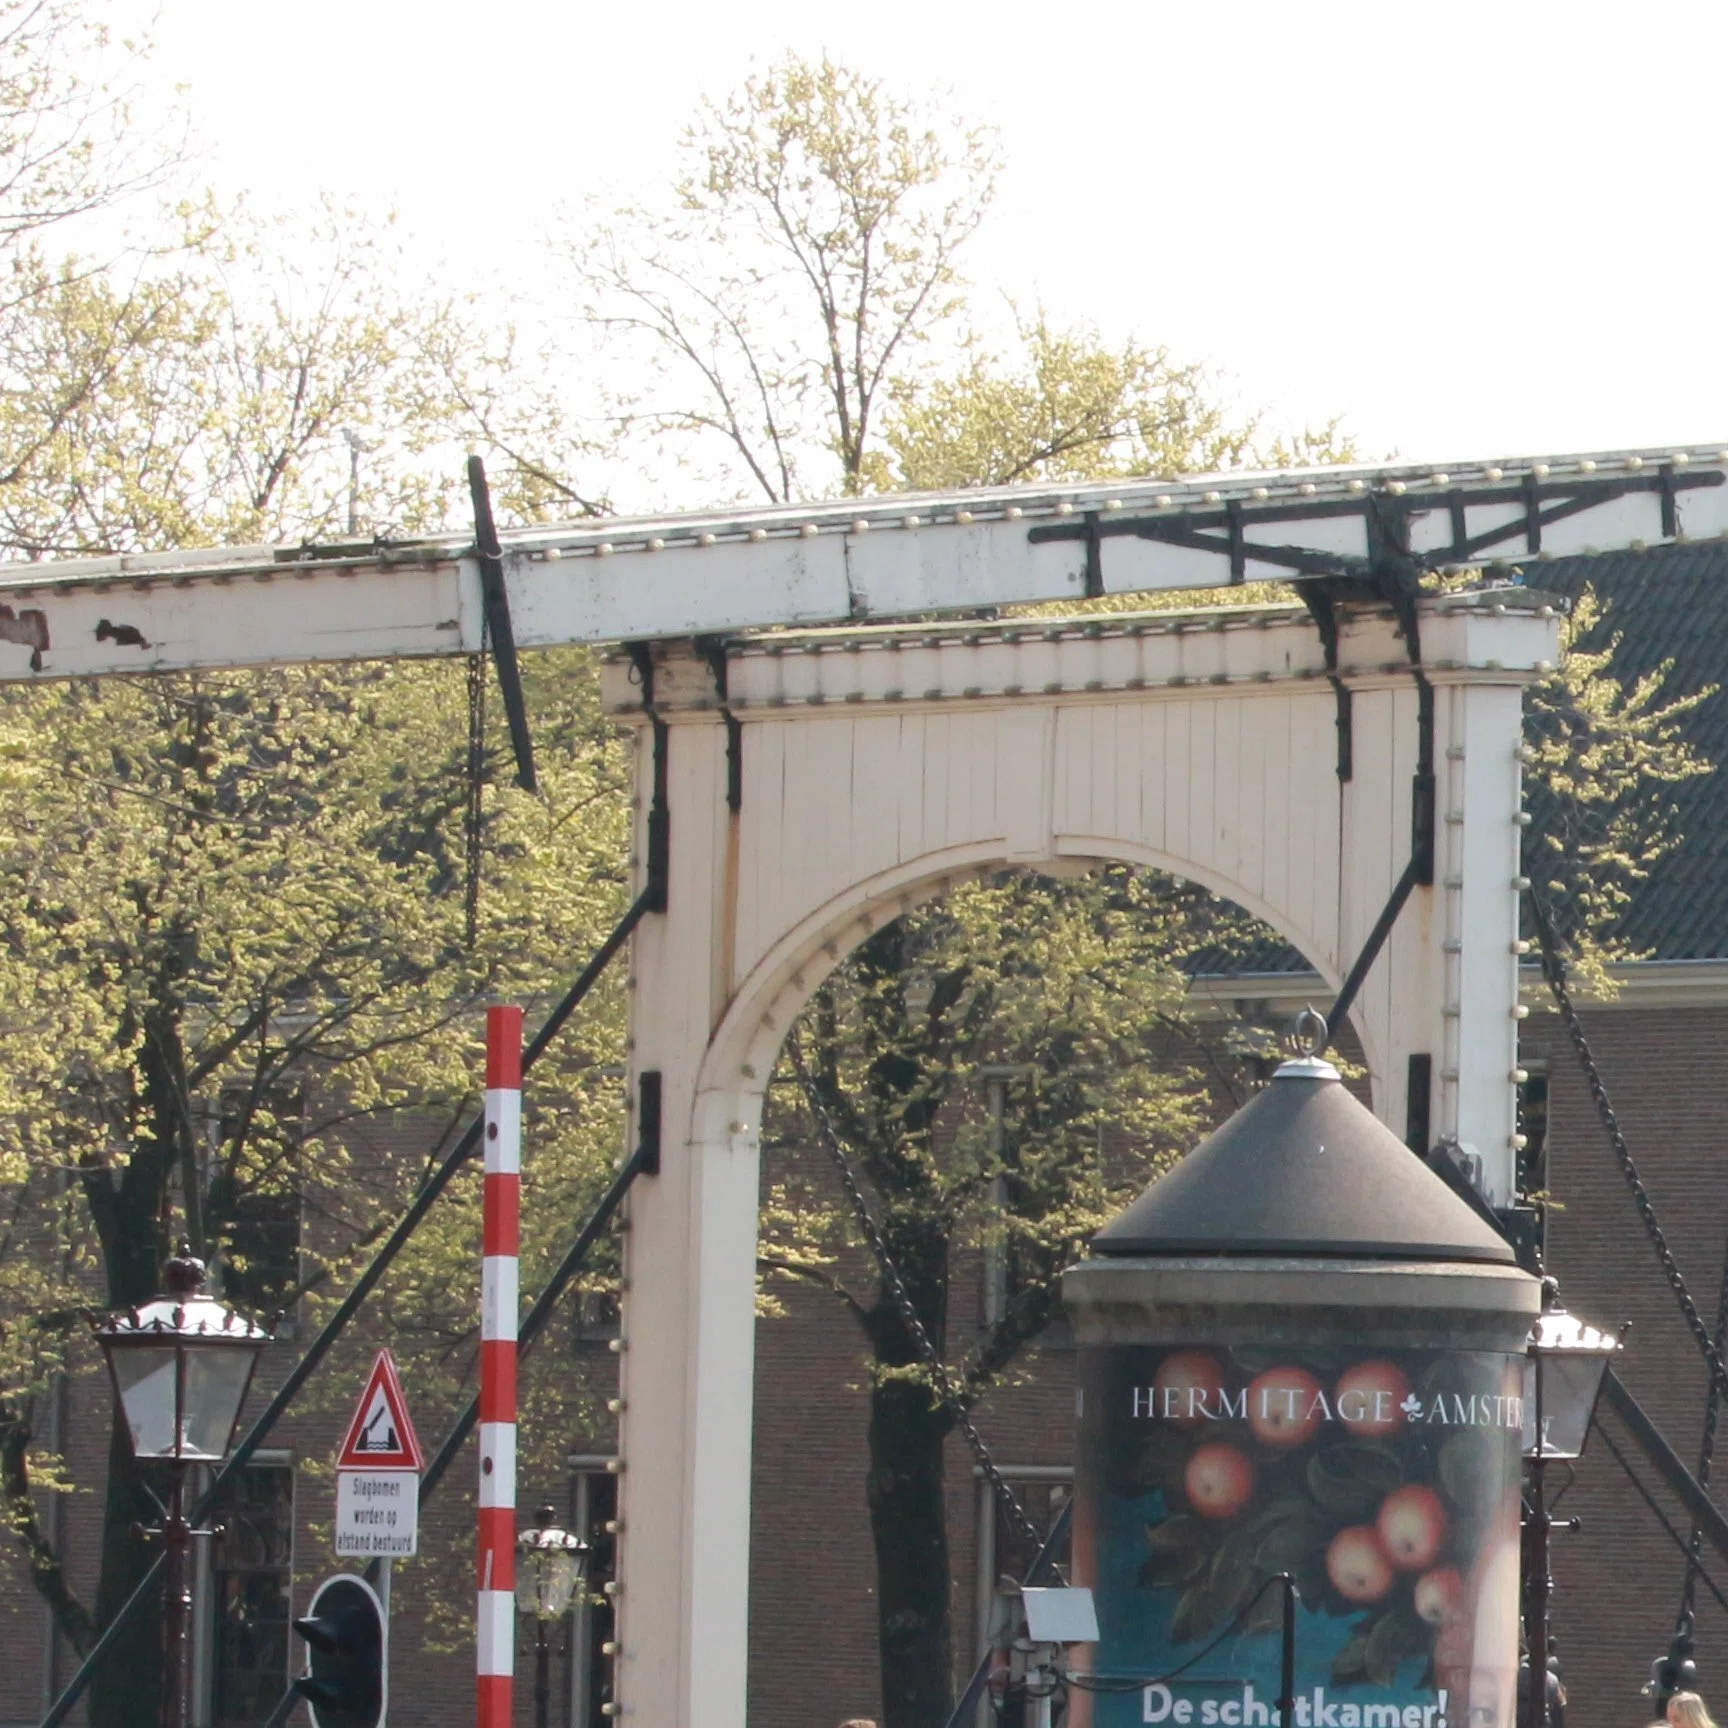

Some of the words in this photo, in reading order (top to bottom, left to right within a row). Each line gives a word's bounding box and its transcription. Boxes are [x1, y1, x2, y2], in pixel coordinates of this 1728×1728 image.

[1132, 1386, 1393, 1423] HERMITAGE
[353, 1476, 400, 1501] Slagbomen
[353, 1507, 384, 1524] worden
[387, 1510, 397, 1528] op
[1143, 1683, 1194, 1724] De
